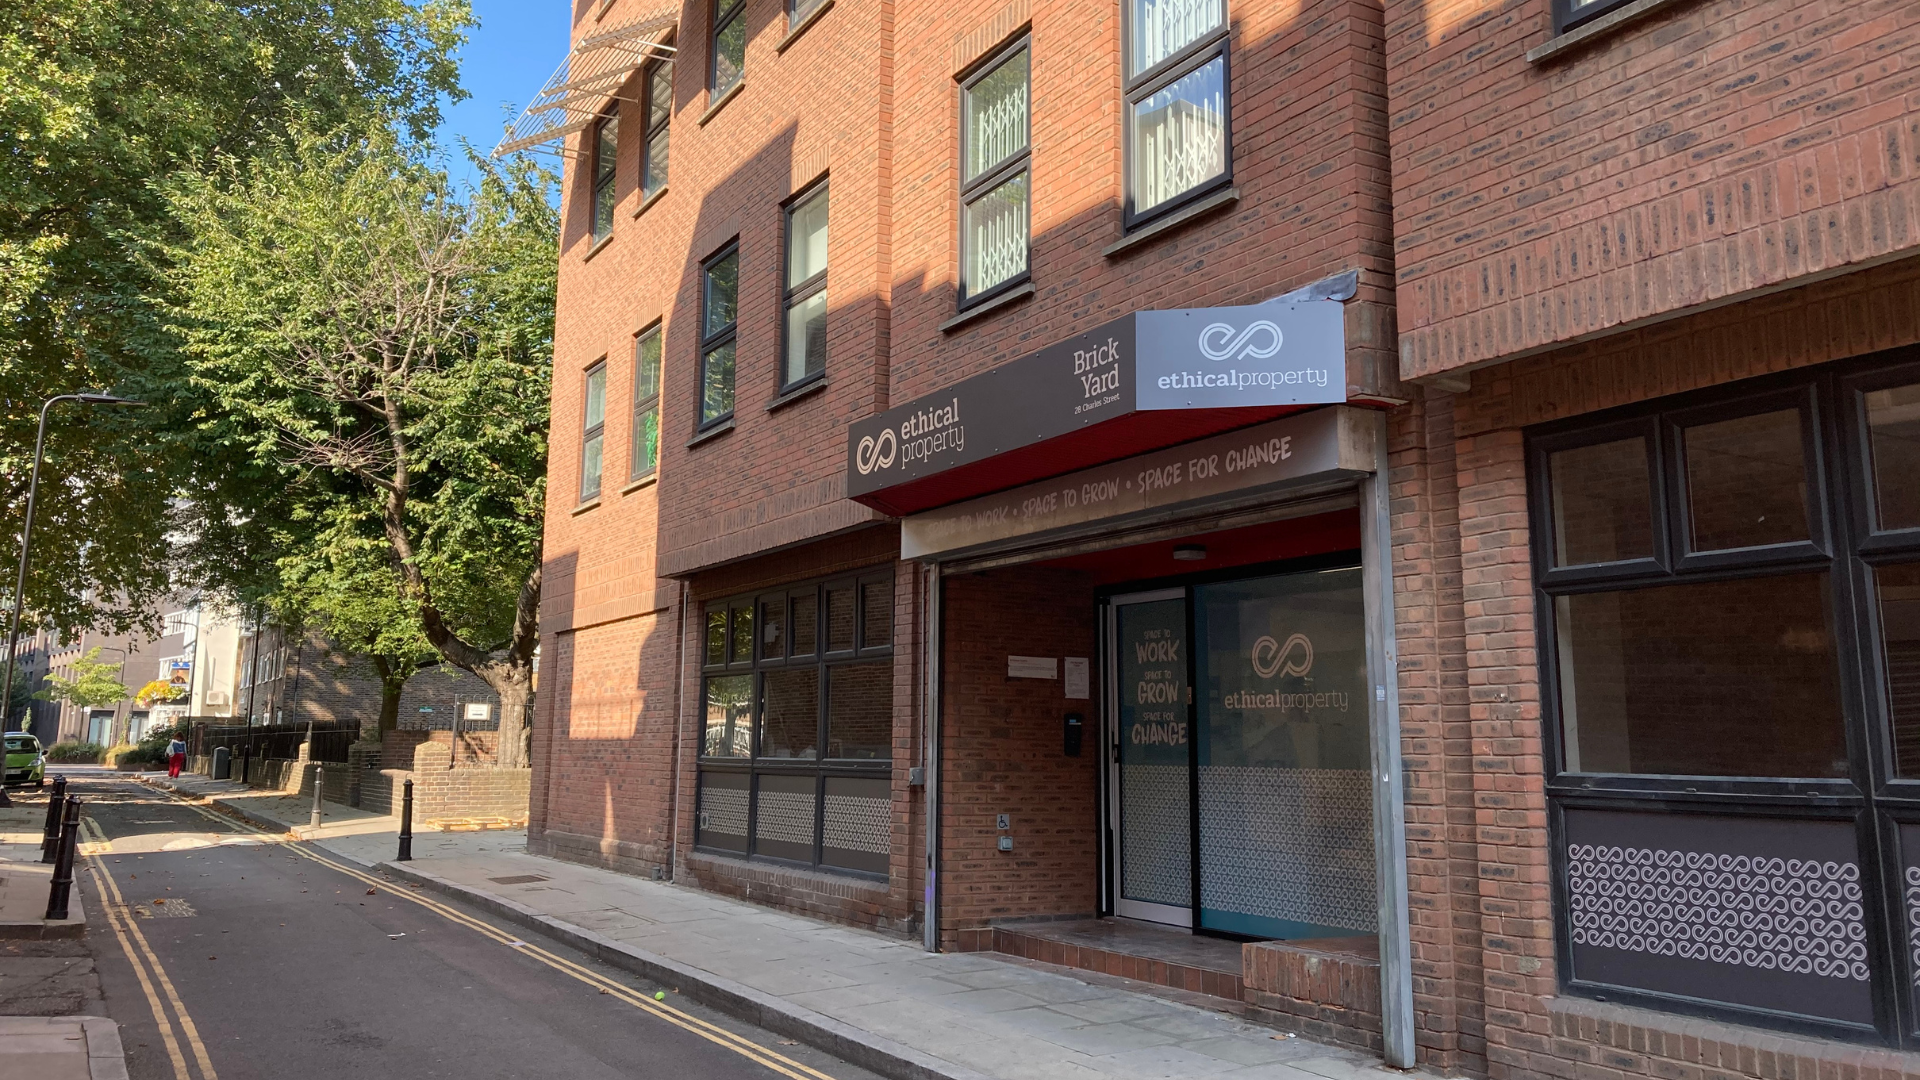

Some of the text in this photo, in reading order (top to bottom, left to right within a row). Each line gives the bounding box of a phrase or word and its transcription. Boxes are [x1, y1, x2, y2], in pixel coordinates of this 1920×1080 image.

[1073, 337, 1119, 375] Brick
[1081, 363, 1120, 398] Yard
[1157, 367, 1328, 391] ethicalproperty
[1074, 393, 1121, 415] 28 Charles Street
[901, 397, 960, 440] ethical
[901, 425, 965, 470] property
[926, 436, 1292, 538] SPACE TO WORK SPACE TO GROW SPACE FOR CHANGE
[1143, 629, 1171, 640] SPACE TO
[1135, 639, 1180, 664] WORK
[1144, 670, 1172, 680] SPACE TO
[1137, 681, 1179, 705] GROW
[1224, 689, 1348, 713] ethicalproperty
[1143, 711, 1175, 721] SPACE FOR
[1131, 722, 1187, 746] CHANGE
